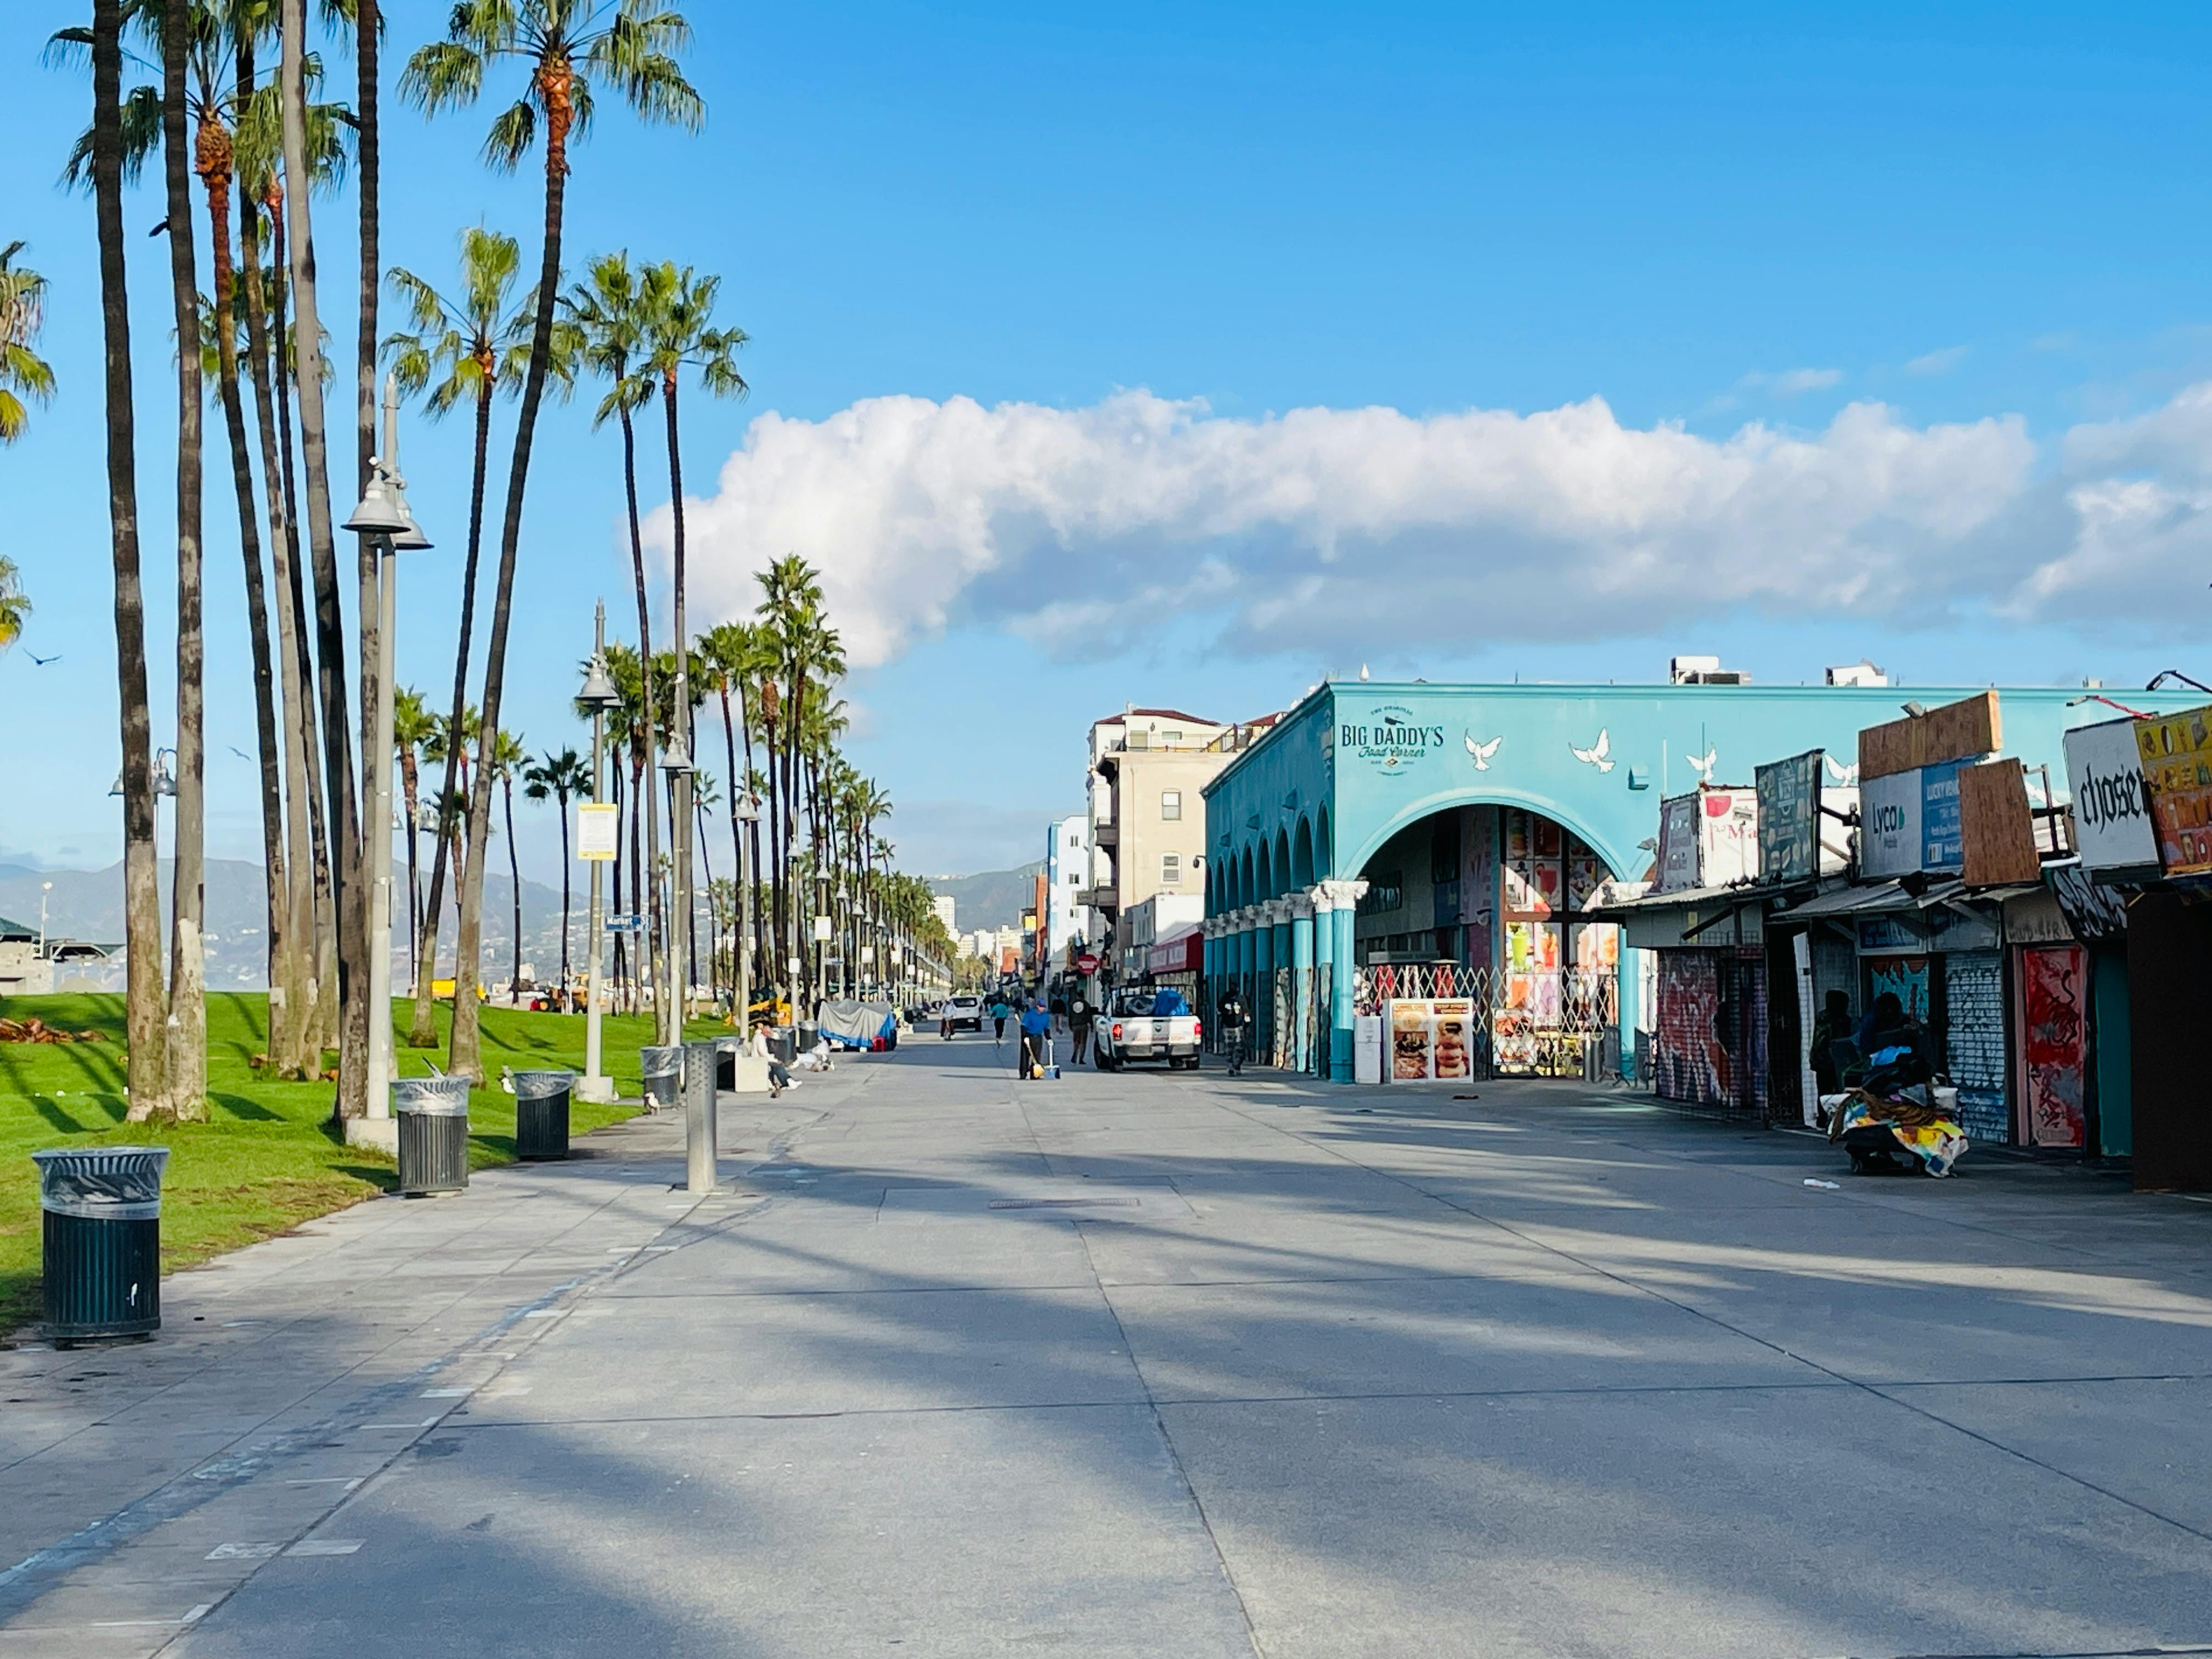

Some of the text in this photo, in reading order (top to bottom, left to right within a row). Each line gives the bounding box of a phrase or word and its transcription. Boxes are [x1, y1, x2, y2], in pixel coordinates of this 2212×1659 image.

[1342, 725, 1444, 747] BIG DADDY'S
[1358, 746, 1388, 758] Food
[607, 916, 633, 926] Market
